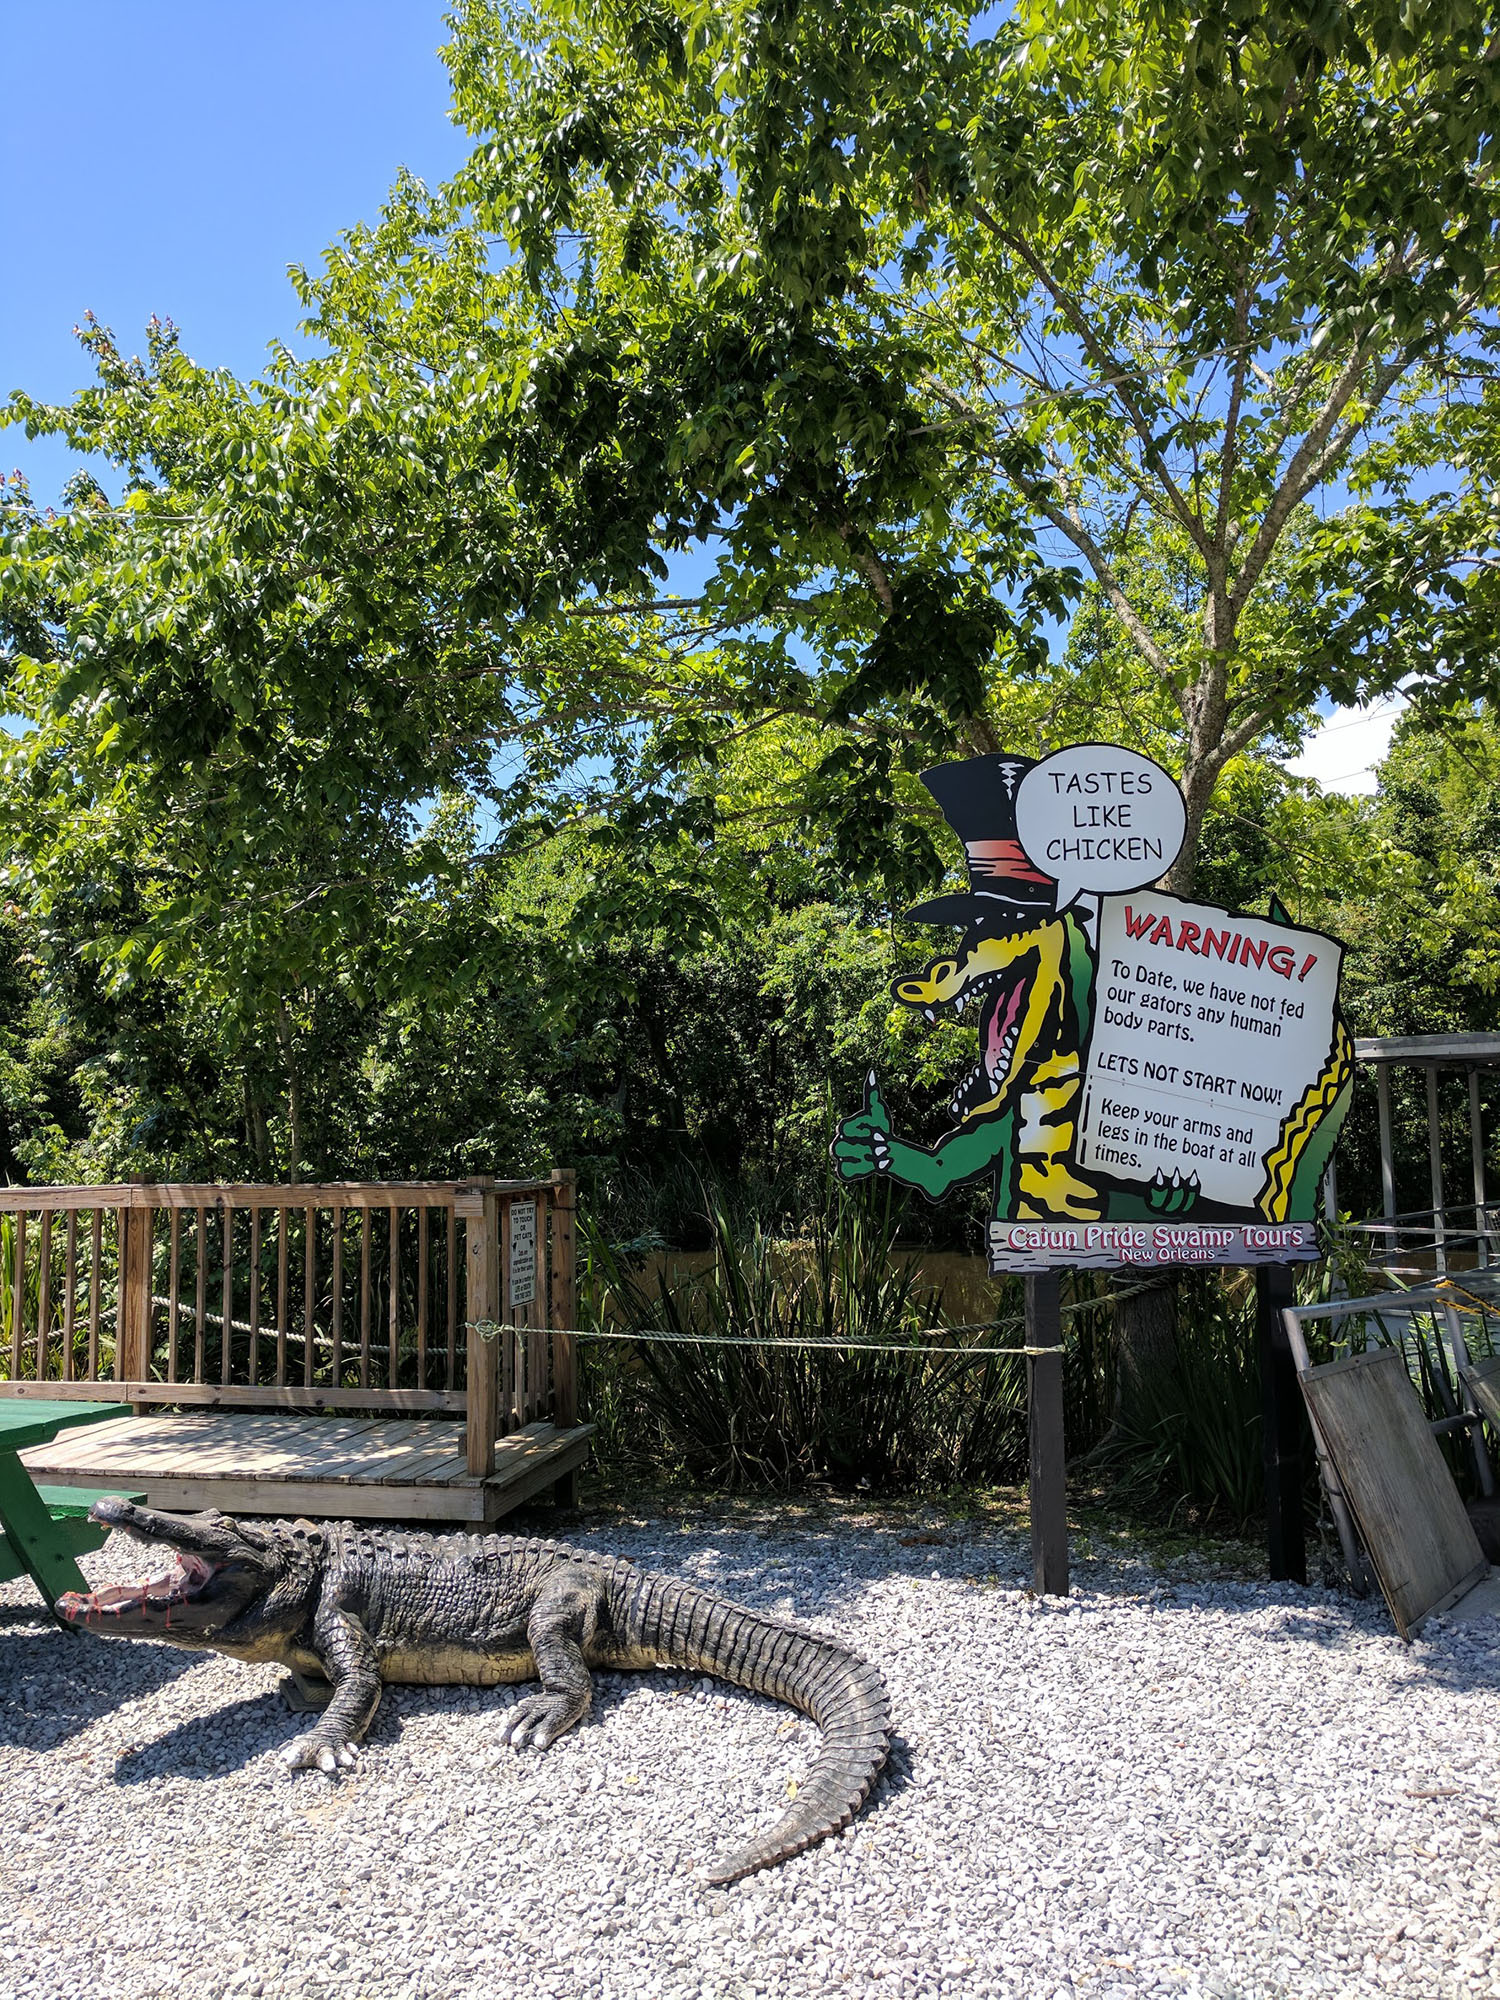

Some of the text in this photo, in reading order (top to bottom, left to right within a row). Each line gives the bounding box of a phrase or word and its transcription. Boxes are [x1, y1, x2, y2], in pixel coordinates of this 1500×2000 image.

[1048, 771, 1152, 794] TASTES
[1073, 804, 1131, 828] LIKE
[1046, 837, 1163, 861] CHICKEN
[1124, 905, 1318, 983] WARNING!
[1111, 959, 1305, 1020] To Date, we have not fed
[1104, 1006, 1195, 1043] body parts.
[1107, 986, 1282, 1037] our gators any human
[1097, 1052, 1284, 1106] LETS NOT START NOW!
[1101, 1098, 1254, 1145] Keep your arms and
[1095, 1144, 1143, 1169] times.
[1097, 1120, 1257, 1168] legs in the boat at all
[1008, 1225, 1304, 1249] Cajun Pride Swamp Tours
[1119, 1247, 1216, 1263] New Orleans
